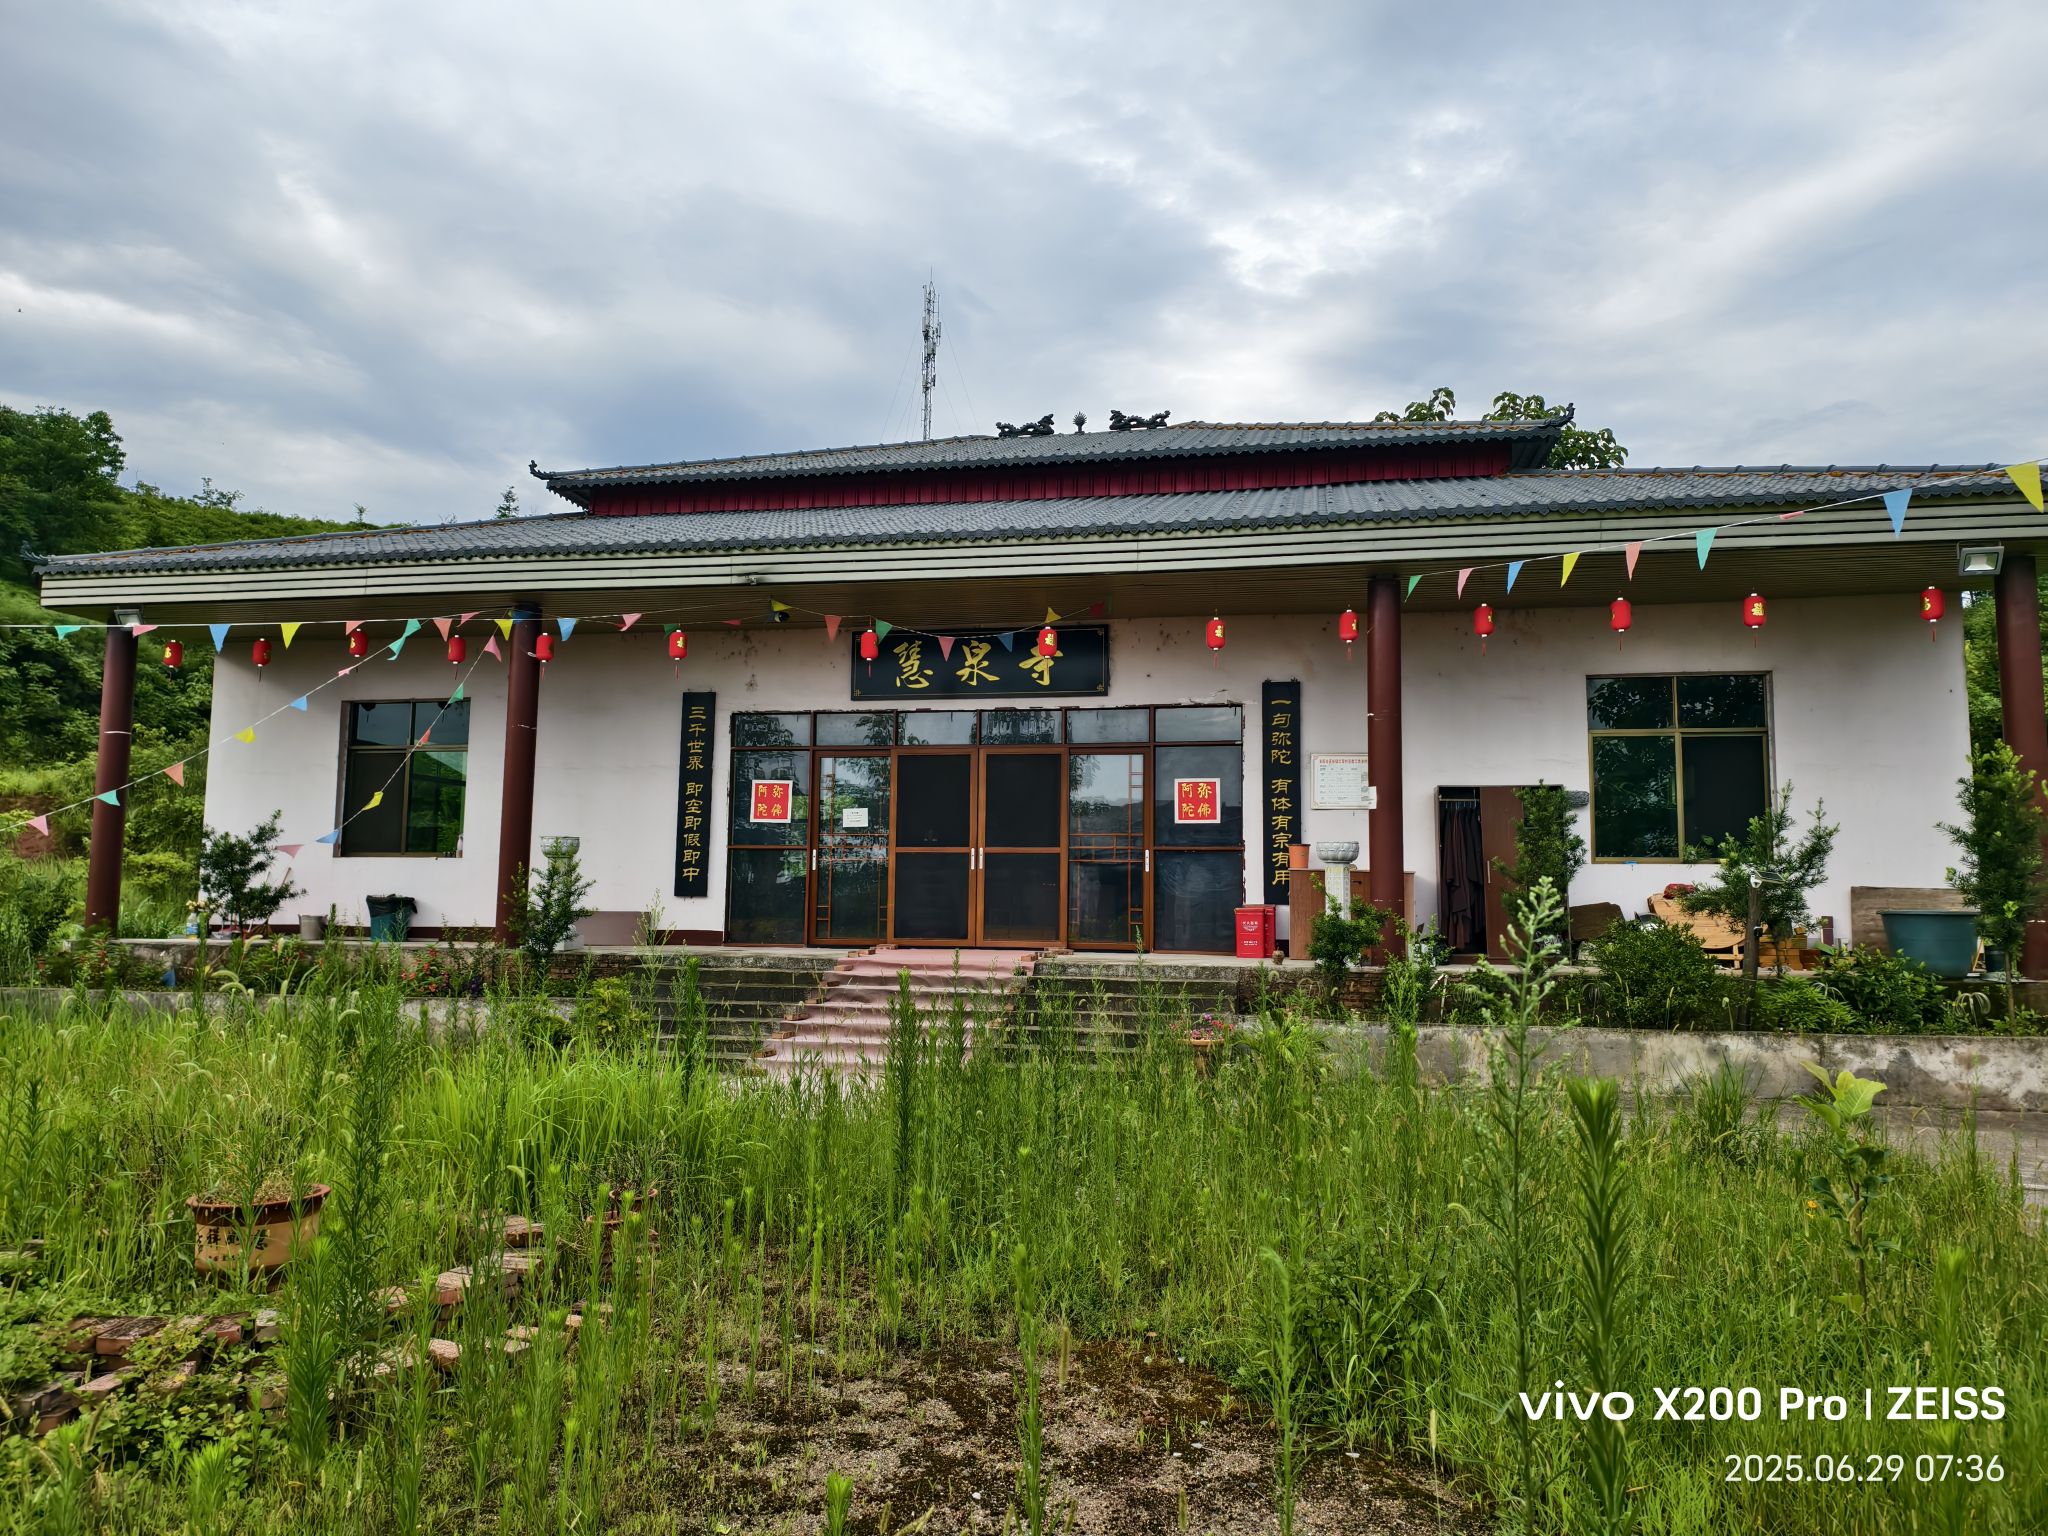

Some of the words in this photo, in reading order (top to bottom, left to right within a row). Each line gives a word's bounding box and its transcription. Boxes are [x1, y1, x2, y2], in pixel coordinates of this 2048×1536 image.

[893, 640, 1063, 689] 慧泉寺
[686, 706, 707, 771] 三千世界
[1271, 700, 1292, 765] 一句弥陀
[757, 803, 783, 817] 陀佛
[758, 784, 784, 798] 阿弥
[1181, 782, 1212, 799] 阿弥
[1181, 802, 1212, 819] 陀佛
[682, 782, 704, 882] 即空即假即中
[1271, 778, 1293, 886] 有体有宗有用
